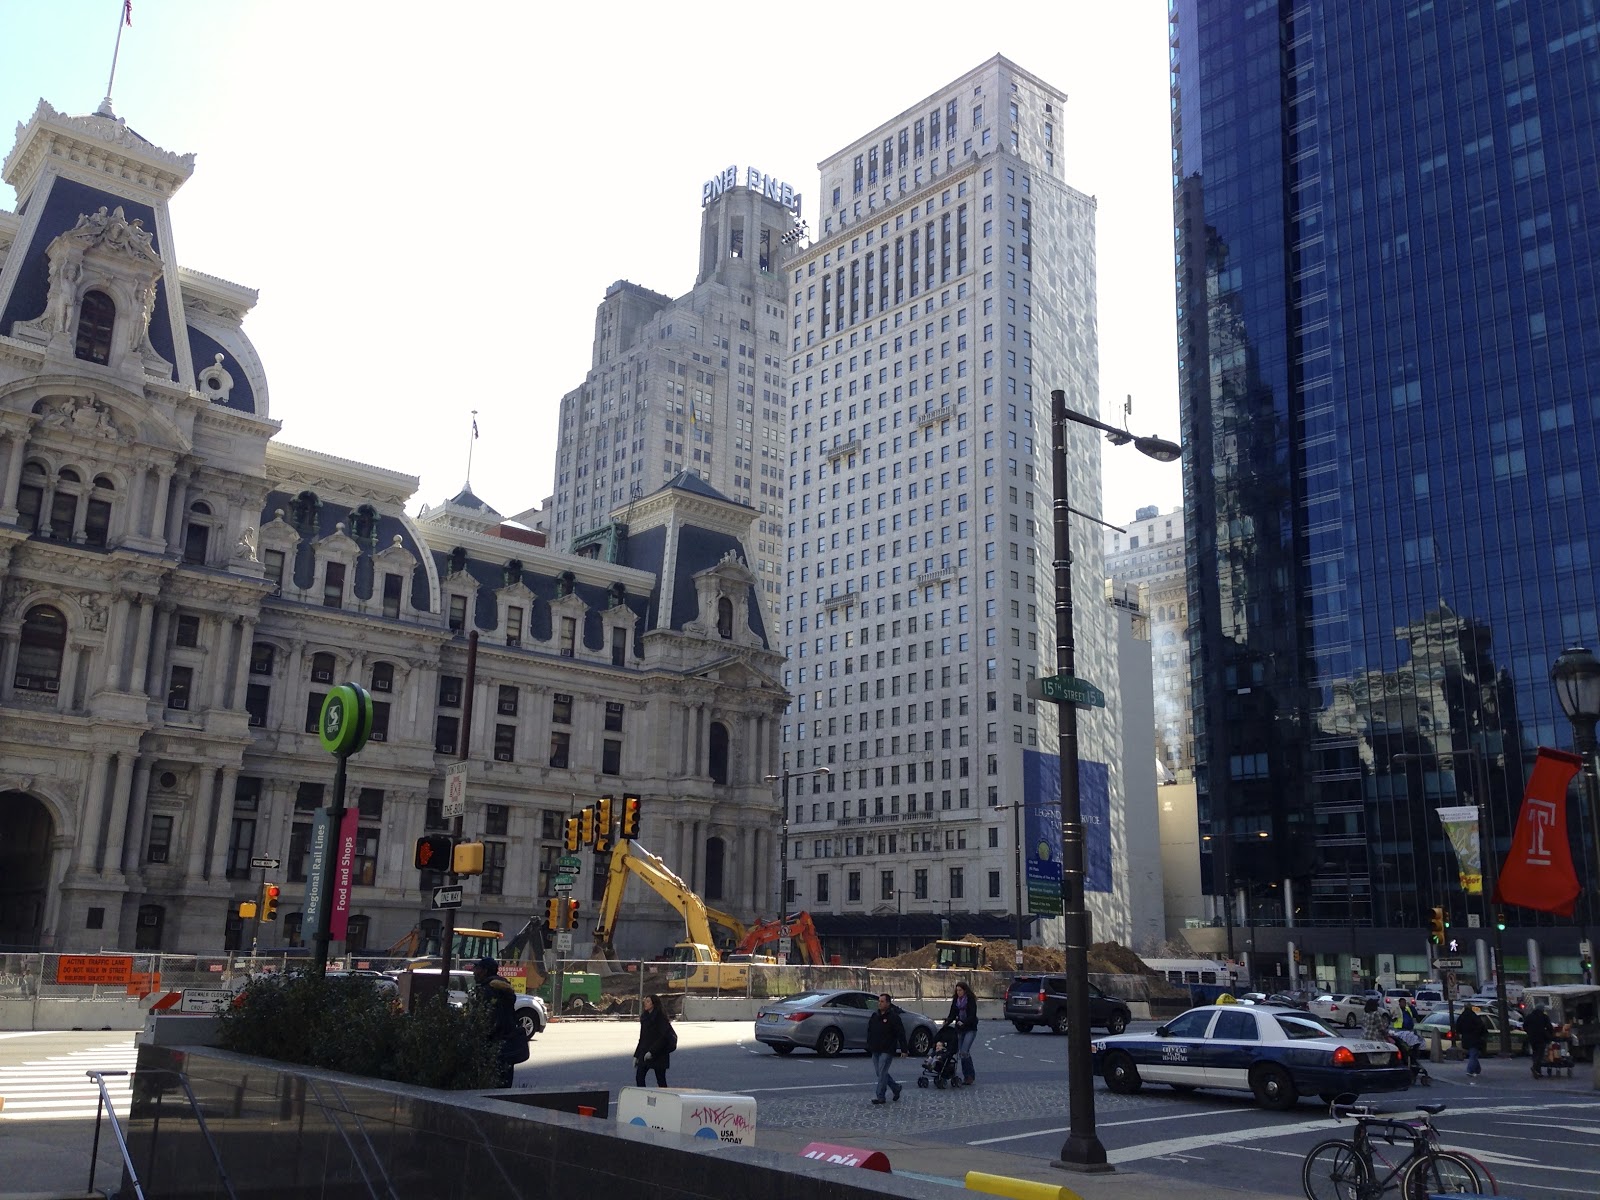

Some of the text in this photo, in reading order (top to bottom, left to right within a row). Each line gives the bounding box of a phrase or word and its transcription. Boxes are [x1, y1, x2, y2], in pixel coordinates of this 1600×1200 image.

[702, 165, 737, 208] PNB
[747, 166, 795, 209] PNB
[1043, 681, 1062, 696] 15TH
[1064, 689, 1085, 701] STREET
[1034, 807, 1062, 820] LEGEND
[308, 824, 326, 914] Regional Rail Lines
[336, 836, 354, 911] Food and Shops
[441, 892, 460, 902] ONE WAY
[720, 1130, 734, 1138] USA
